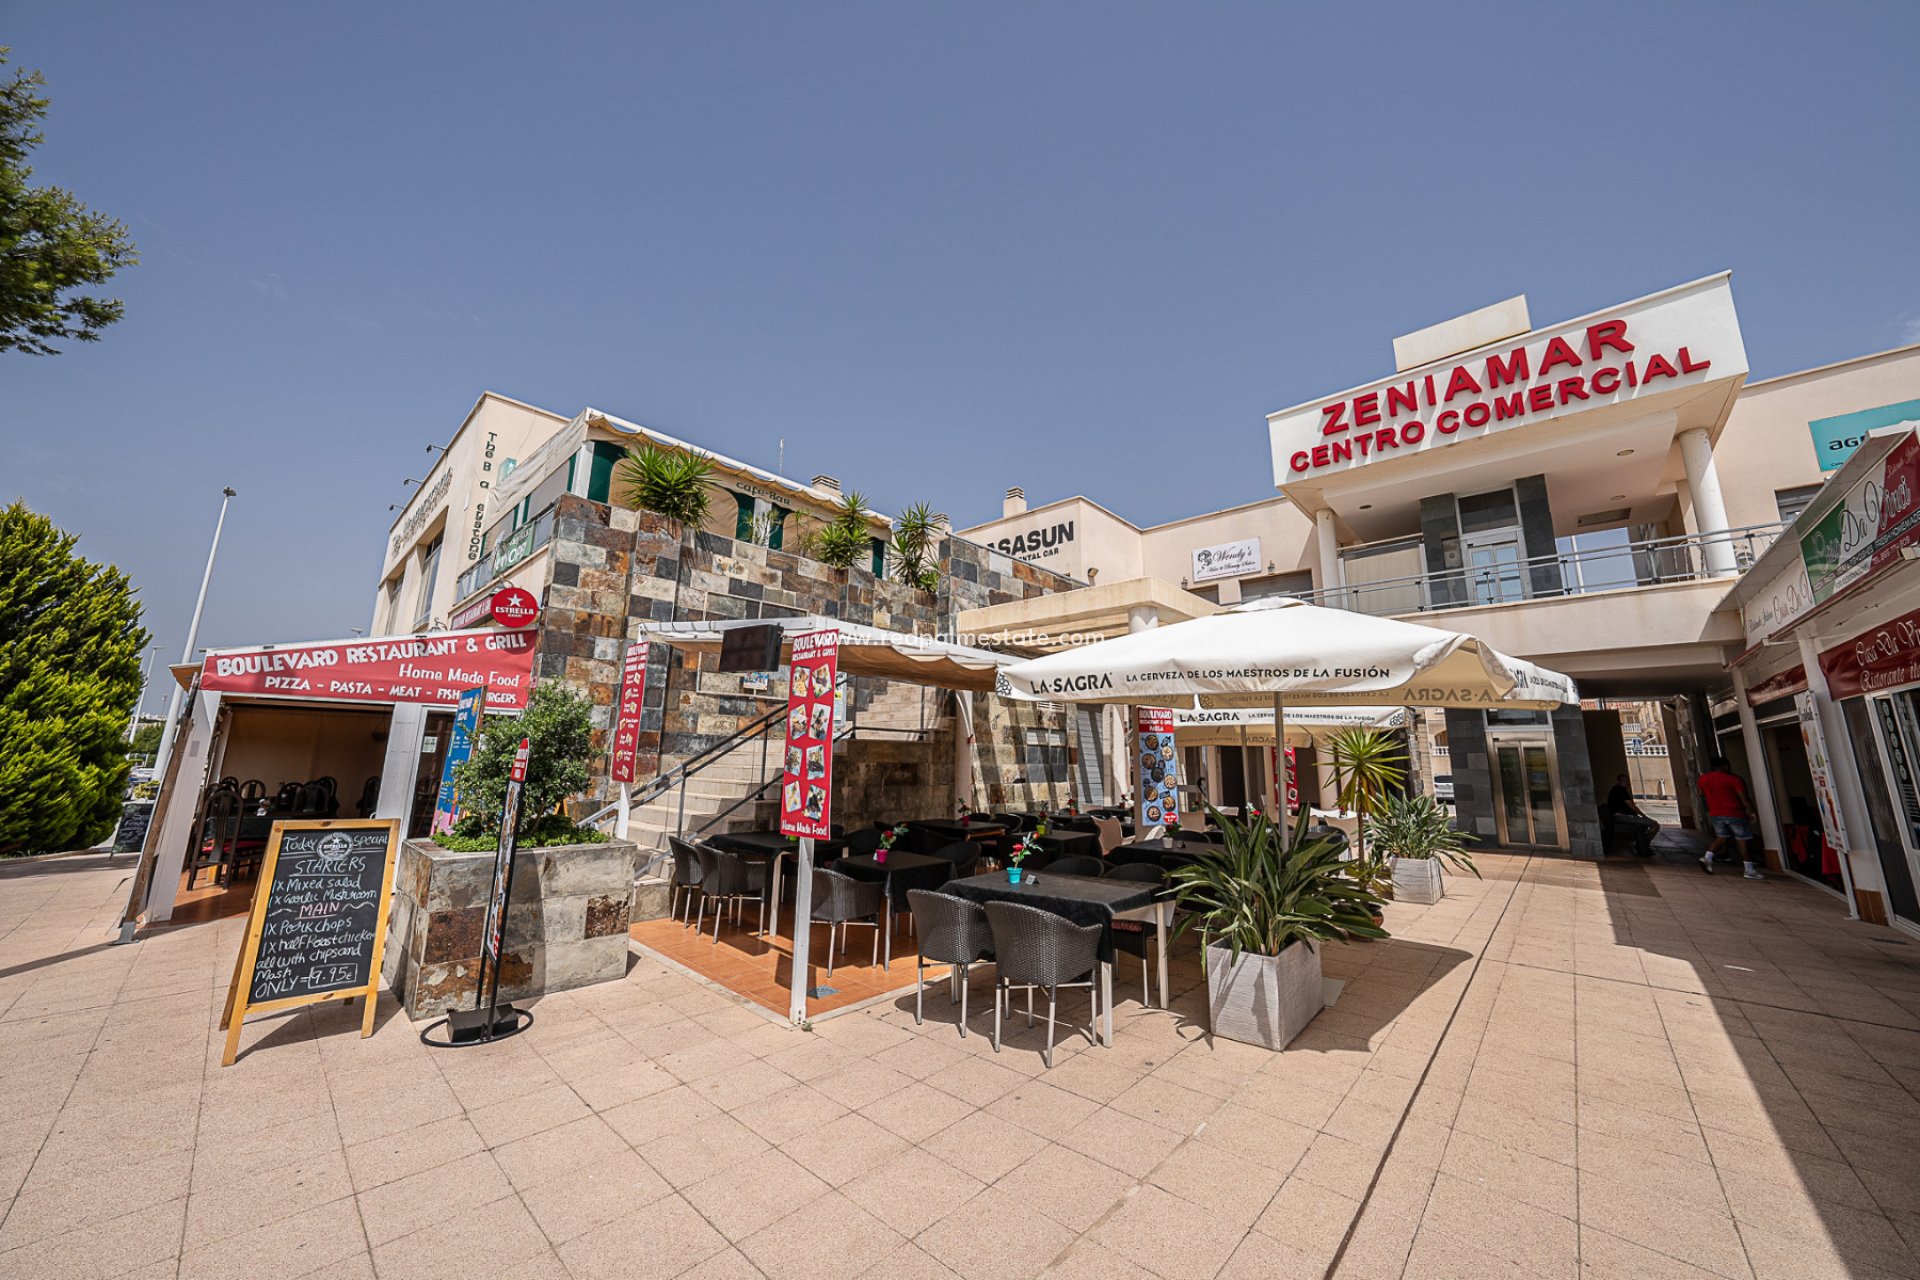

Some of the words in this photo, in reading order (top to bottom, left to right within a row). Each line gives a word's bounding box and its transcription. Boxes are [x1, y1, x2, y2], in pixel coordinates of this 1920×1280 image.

[1322, 318, 1635, 437] ZENIAMAR
[1289, 420, 1425, 473] CENTRO
[1436, 346, 1711, 435] COMERCIAL
[987, 520, 1074, 556] SASUN
[1043, 547, 1059, 558] CAR
[1212, 546, 1252, 562] Wendy's
[495, 606, 534, 615] ESTRELLA
[793, 632, 838, 652] BOULEVARD
[216, 649, 339, 677] BOULEVARD
[346, 640, 458, 664] RESTAURANT
[466, 639, 478, 652] &
[485, 633, 527, 650] GRILL
[1856, 641, 1878, 666] Casa
[399, 664, 443, 682] Home
[448, 668, 484, 684] Made
[488, 671, 520, 688] Food
[1126, 674, 1138, 682] LA
[1140, 671, 1185, 681] CERVEZA
[1187, 670, 1200, 679] DE
[1202, 669, 1223, 678] LOS
[1226, 668, 1290, 678] MAESTROS
[1294, 668, 1309, 678] DE
[1312, 668, 1330, 678] LA
[1335, 665, 1390, 678] FUSIÓN
[1860, 667, 1905, 692] Ristorante
[265, 676, 310, 690] PIZZA
[330, 681, 372, 696] PASTA
[389, 685, 420, 698] MEAT
[436, 688, 460, 700] FISH
[1138, 710, 1172, 719] BOULEVARD
[812, 824, 828, 836] Food
[284, 836, 318, 852] Today
[295, 856, 366, 874] STARTERS
[287, 878, 324, 892] Mixed
[300, 902, 340, 918] MAIN
[256, 957, 276, 970] all
[277, 953, 306, 967] with
[254, 976, 299, 998] ONLY
